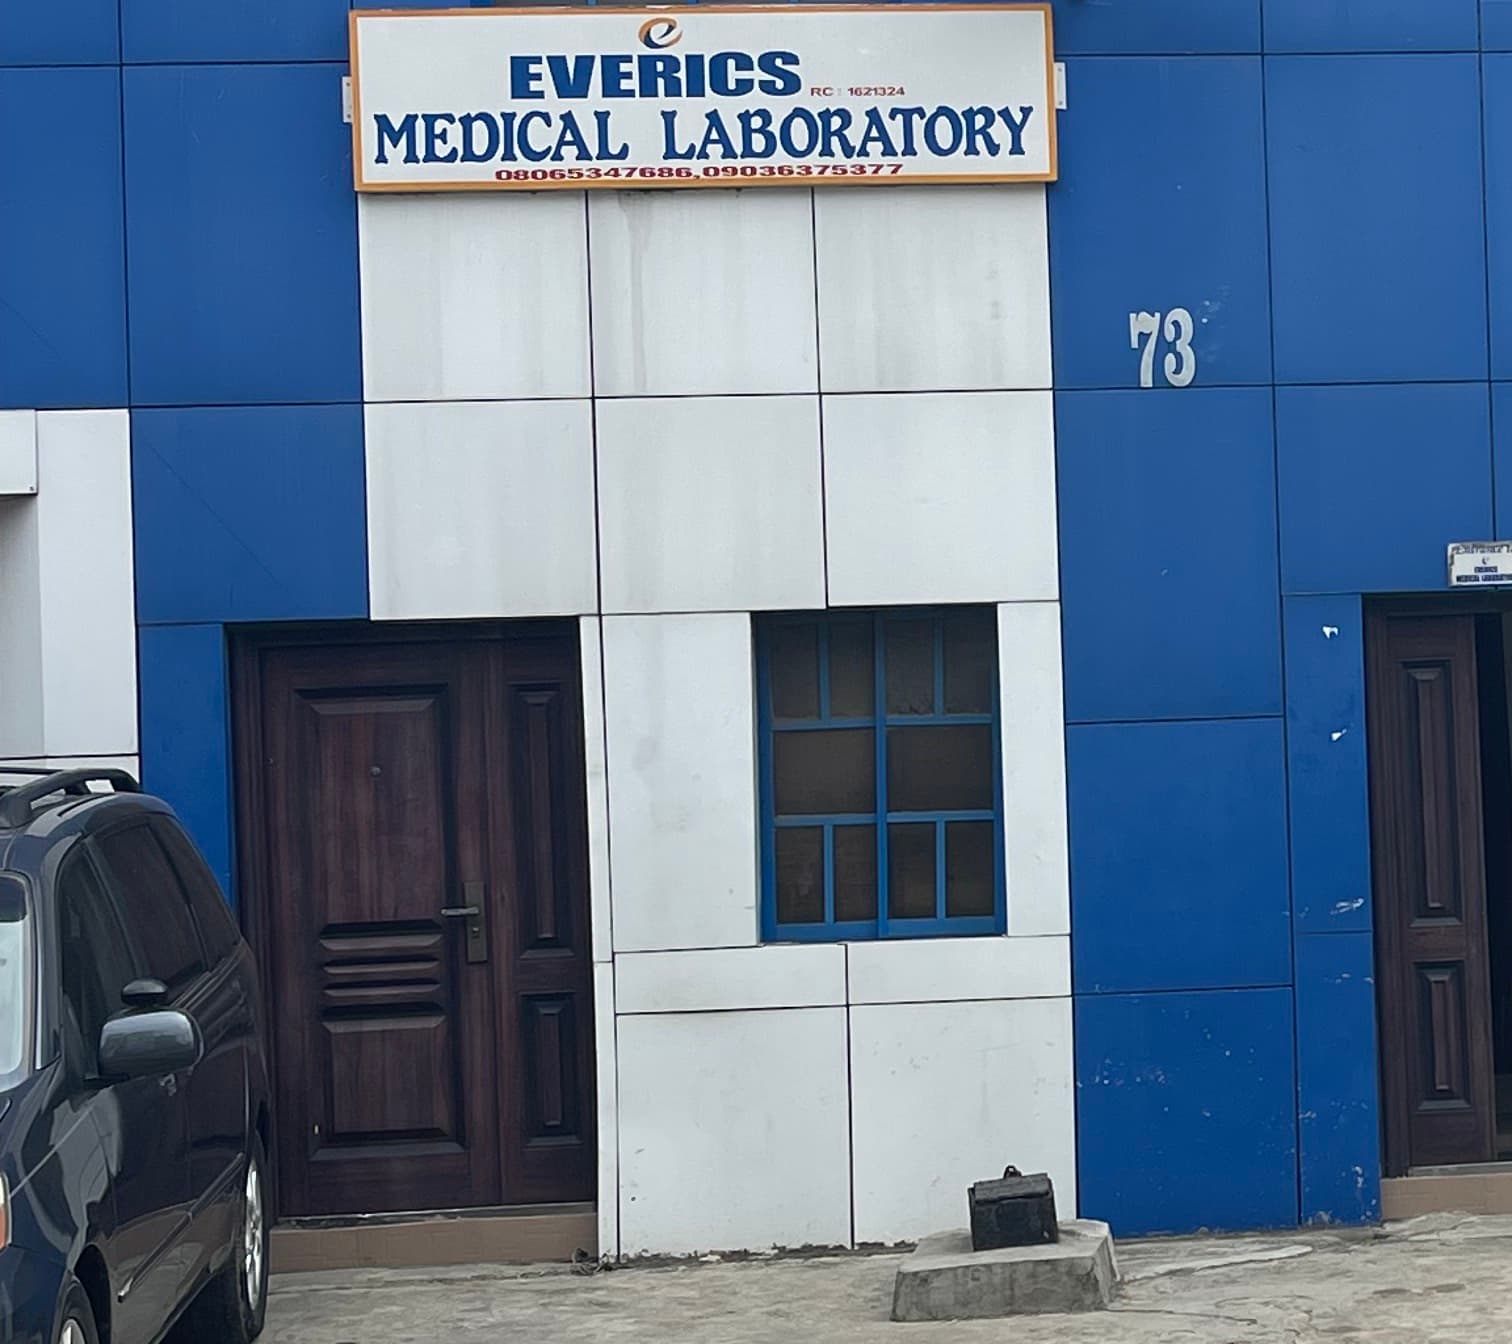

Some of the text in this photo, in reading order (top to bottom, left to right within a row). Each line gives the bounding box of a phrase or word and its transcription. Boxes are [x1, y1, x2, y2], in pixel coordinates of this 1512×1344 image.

[510, 50, 802, 100] EVERICS
[847, 86, 905, 97] 1621324
[374, 105, 1034, 165] MEDICAL LABORATORY
[1129, 307, 1196, 388] 73
